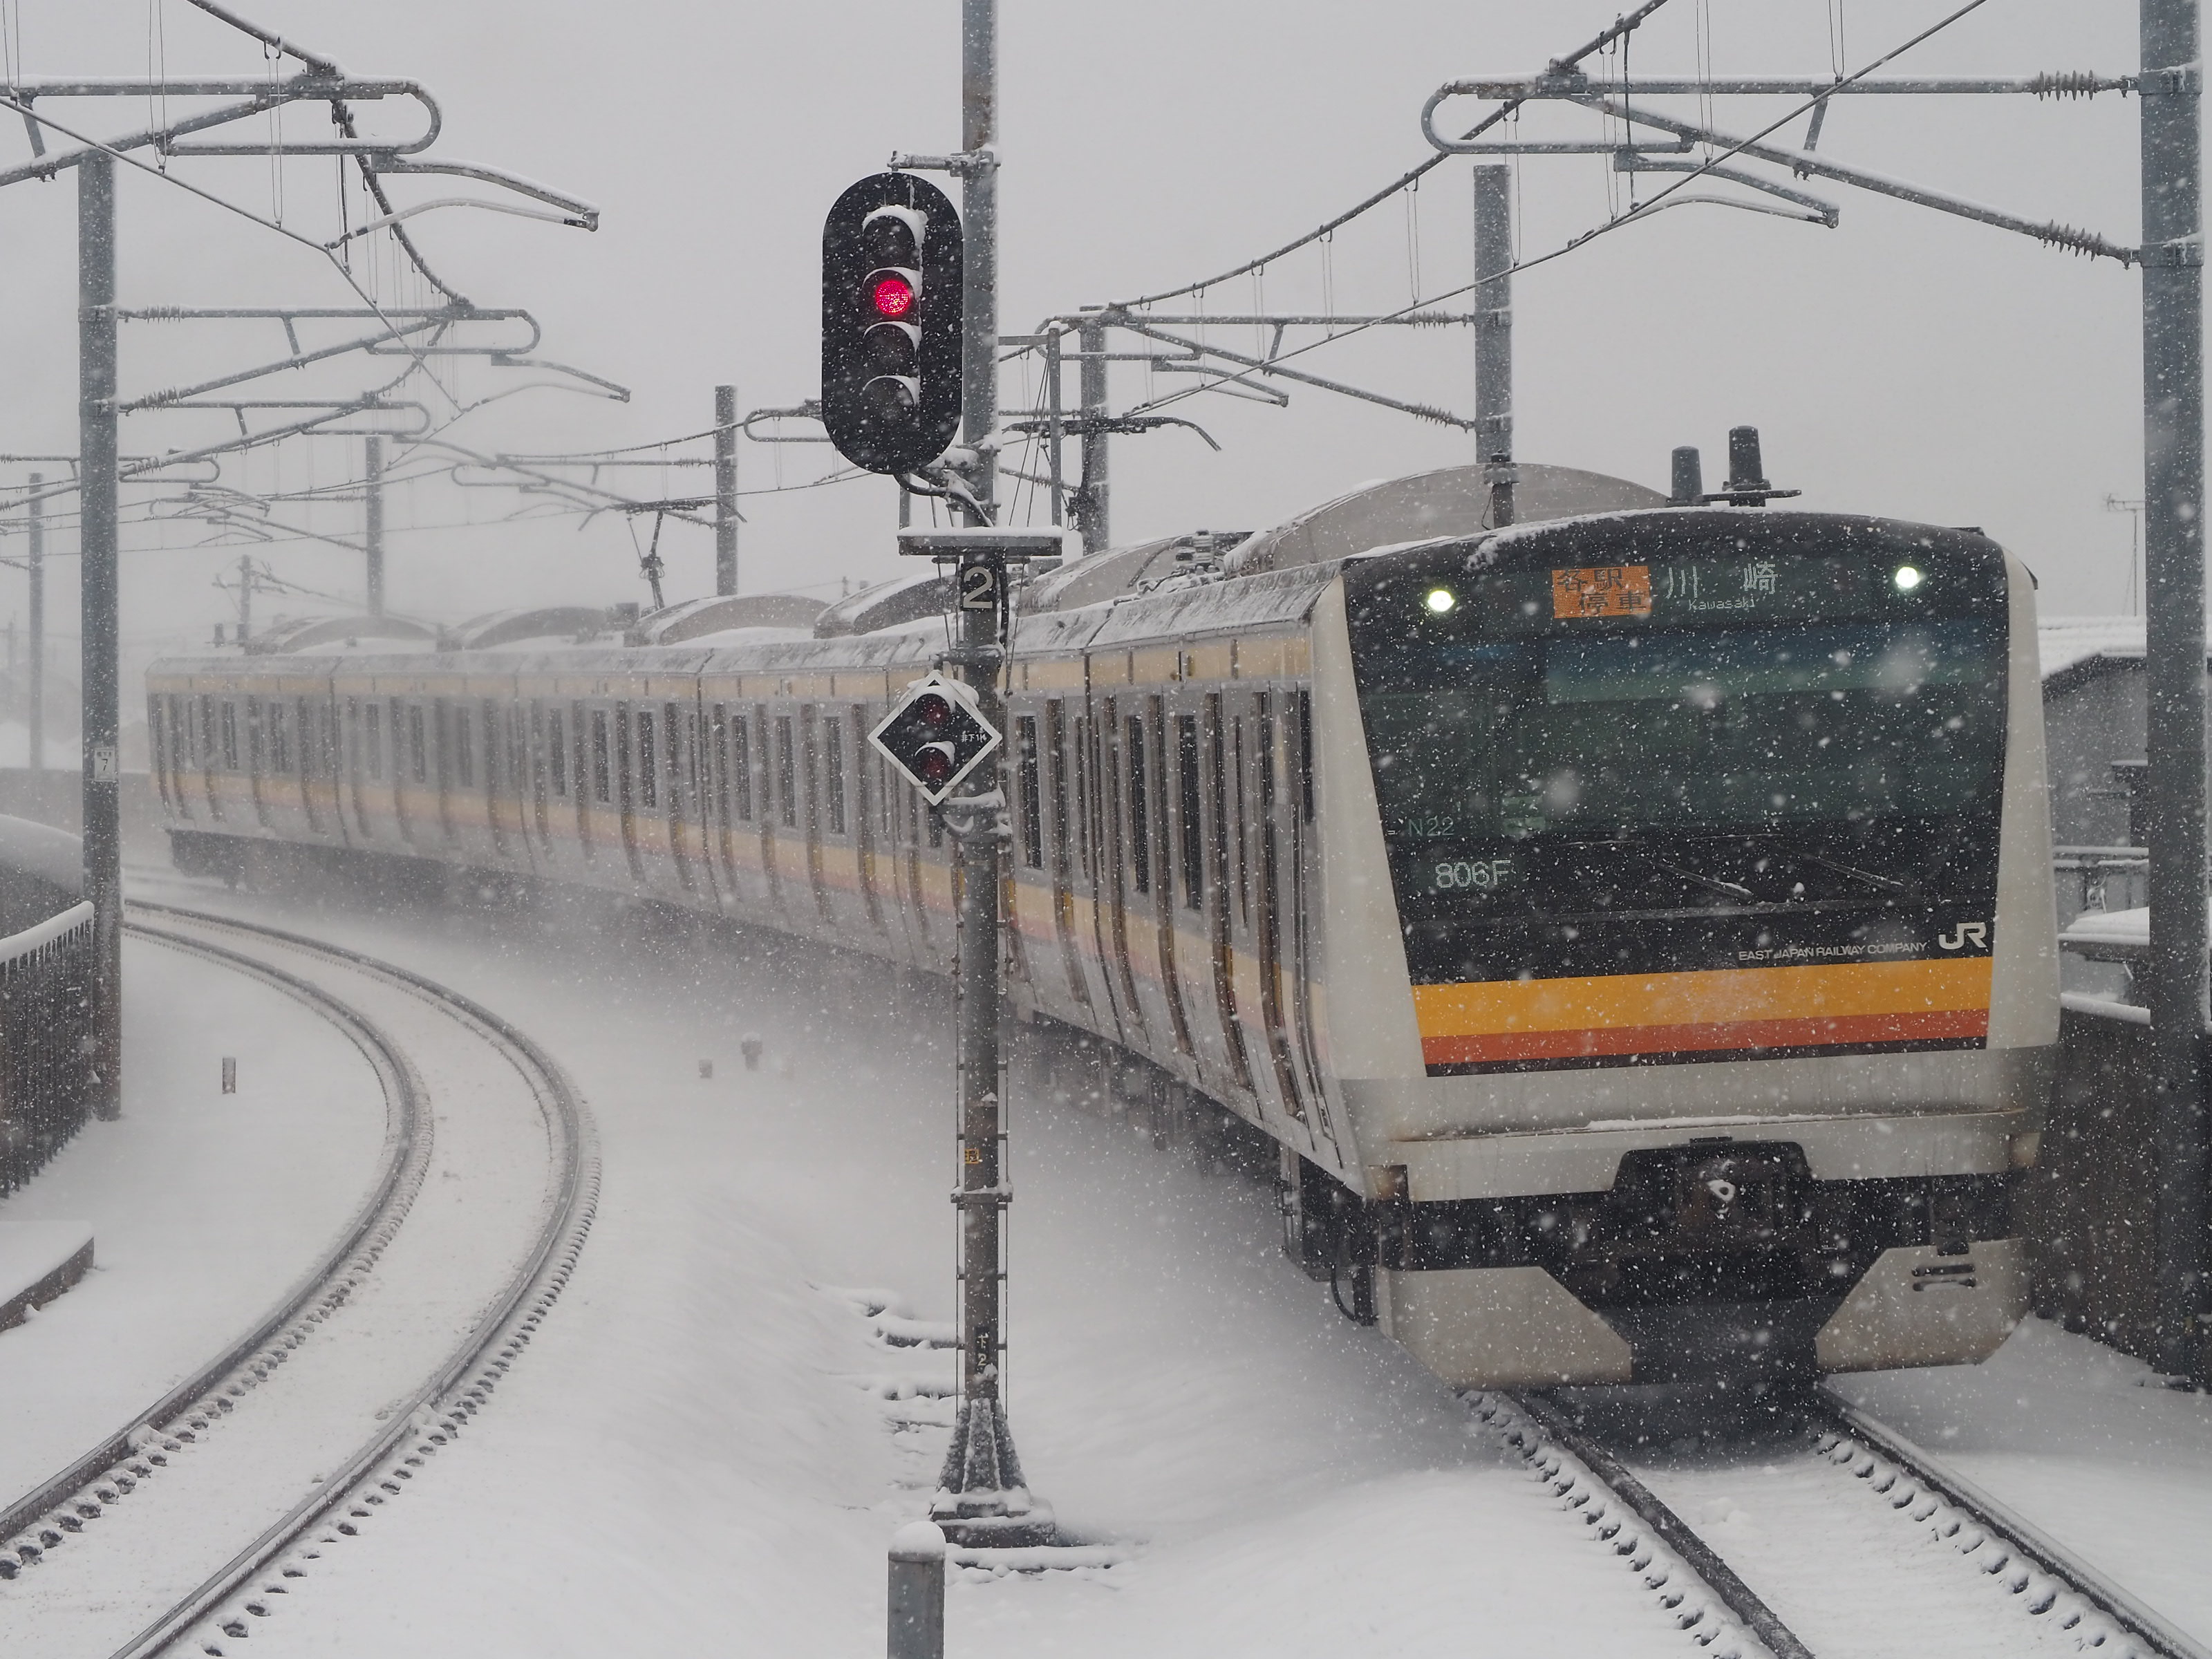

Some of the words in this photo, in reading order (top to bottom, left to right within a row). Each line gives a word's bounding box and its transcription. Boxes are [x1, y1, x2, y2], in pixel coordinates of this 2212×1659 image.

[962, 566, 994, 609] 2
[1557, 568, 1623, 592] 各駅
[1665, 561, 1779, 599] 川崎
[1579, 590, 1647, 615] 停車
[1688, 594, 1756, 610] Kawasaki
[101, 758, 108, 771] 7
[1409, 817, 1454, 837] N22
[1435, 859, 1511, 888] 806F
[1938, 922, 1987, 950] JR
[1738, 949, 1772, 961] EAST
[1773, 946, 1815, 959] JAPAN
[1815, 945, 1866, 957] RAILWAY
[1867, 941, 1928, 955] COMPANY
